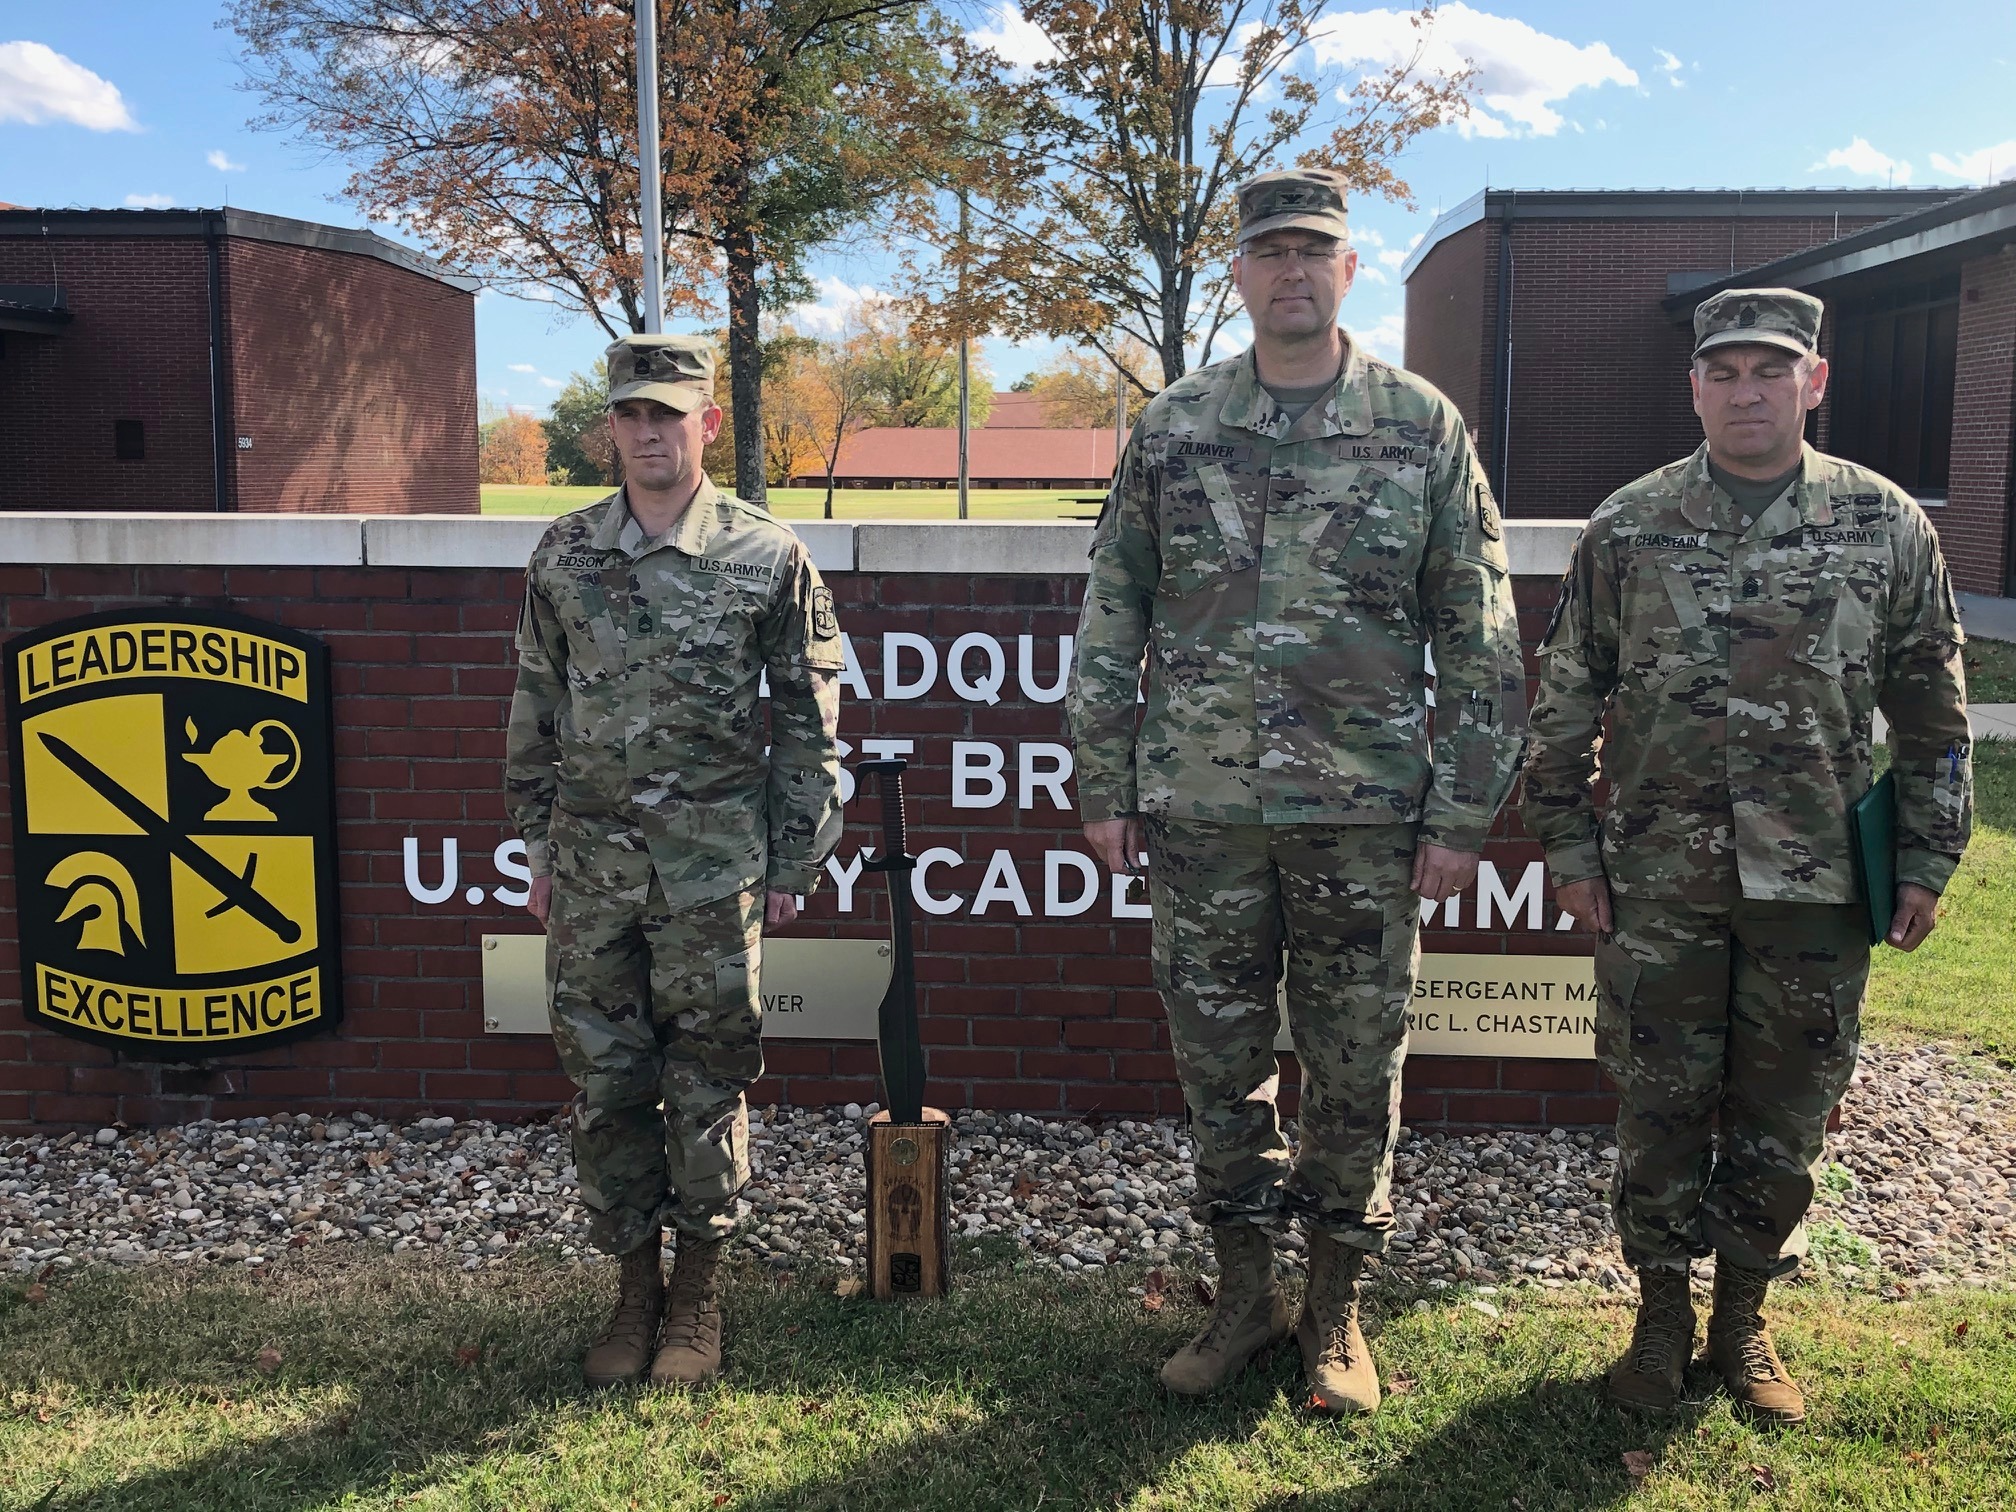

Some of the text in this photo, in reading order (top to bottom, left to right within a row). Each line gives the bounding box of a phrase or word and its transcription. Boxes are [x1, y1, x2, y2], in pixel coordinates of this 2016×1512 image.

[1177, 441, 1235, 458] ZILHAVER
[1380, 445, 1416, 460] ARMY
[1635, 533, 1699, 548] CHASTAIN
[556, 554, 606, 568] EIDSON
[25, 628, 301, 695] LEADERSHIP
[951, 740, 1075, 811] BR
[910, 846, 1153, 919] CADE
[1413, 980, 1599, 1002] SERGEANT MA
[44, 970, 315, 1037] EXCELLENCE
[761, 993, 804, 1013] VER
[1407, 1012, 1597, 1035] RIC L. CHASTAIN
